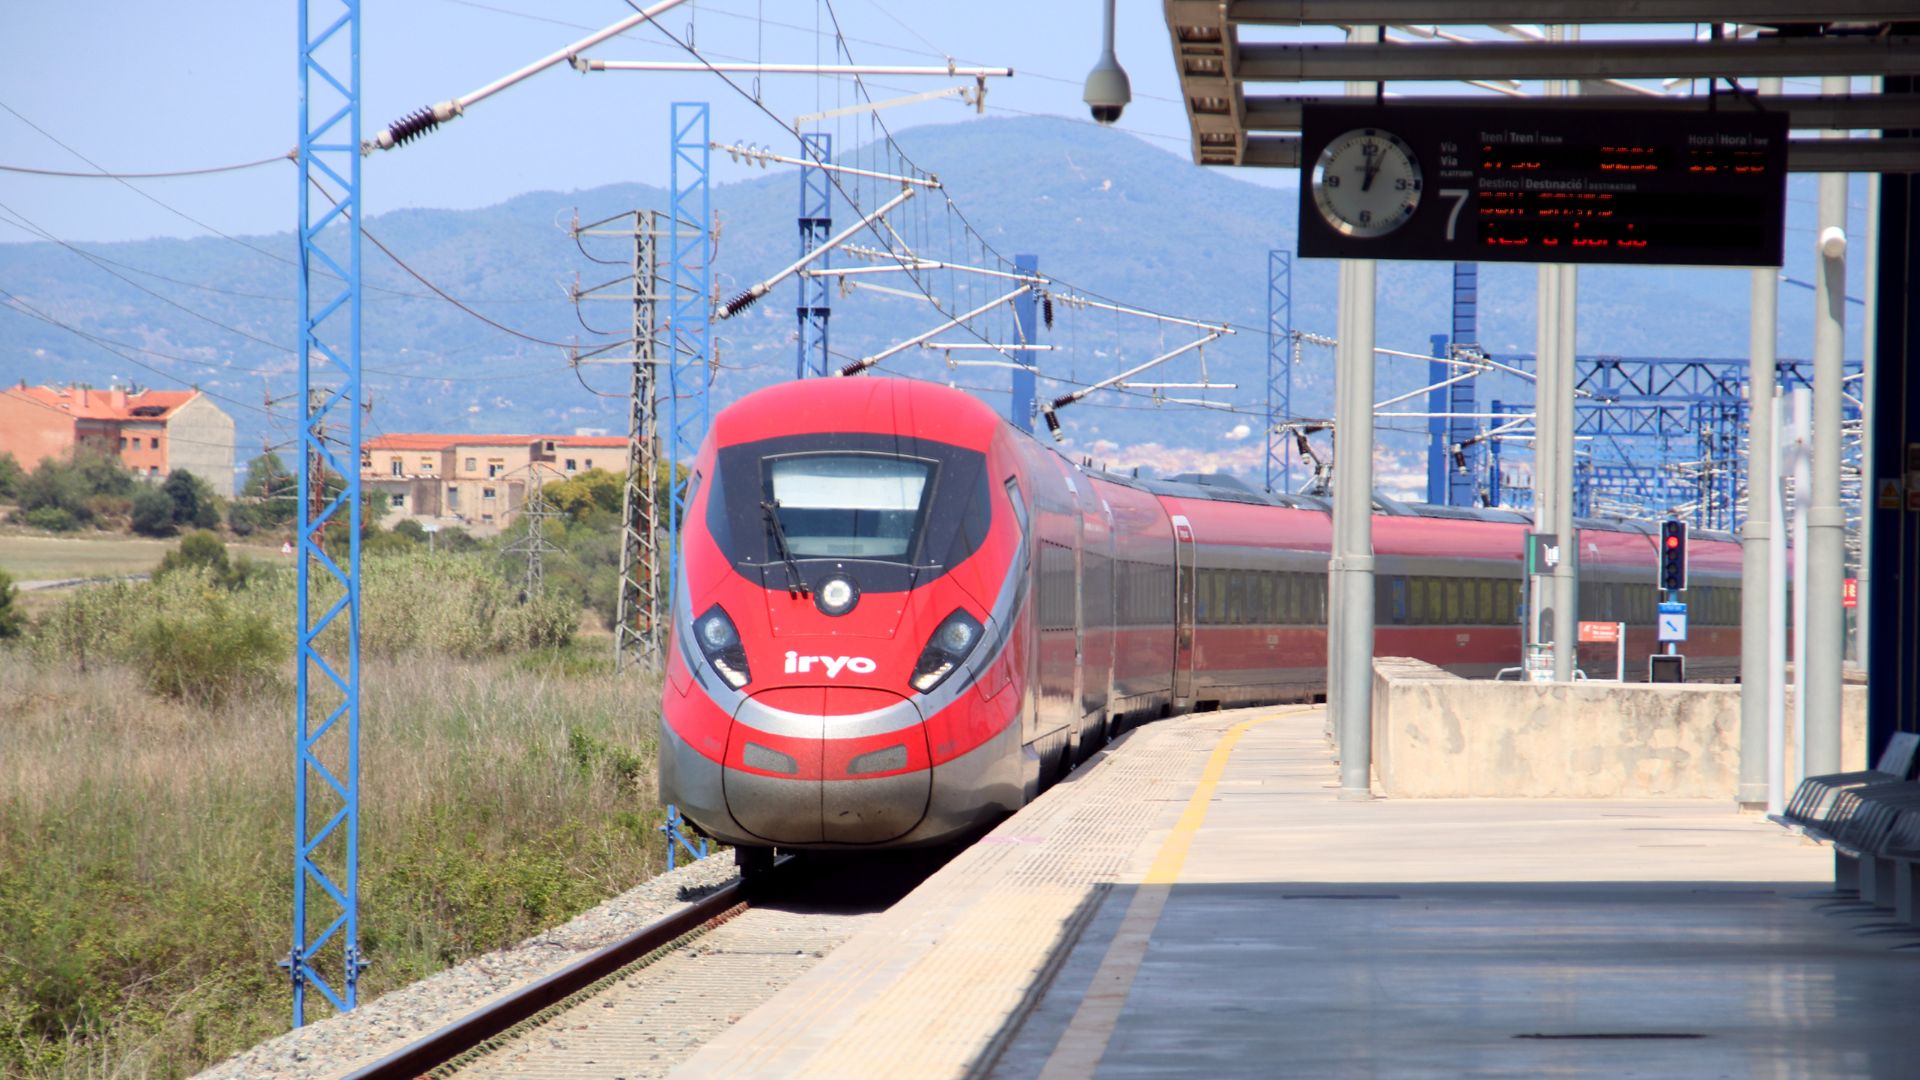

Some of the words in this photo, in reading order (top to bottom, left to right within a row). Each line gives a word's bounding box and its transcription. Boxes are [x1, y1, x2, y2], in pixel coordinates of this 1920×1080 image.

[1480, 131, 1503, 143] Tren
[1509, 131, 1534, 143] Tren
[1688, 133, 1714, 145] Hora
[1720, 133, 1747, 145] Hora
[1328, 175, 1340, 187] 9
[1395, 178, 1406, 190] 3
[1479, 177, 1520, 189] Destino
[1525, 178, 1583, 189] Destinació
[1359, 210, 1370, 222] 6
[1438, 188, 1470, 241] 7
[784, 650, 877, 679] iryo
